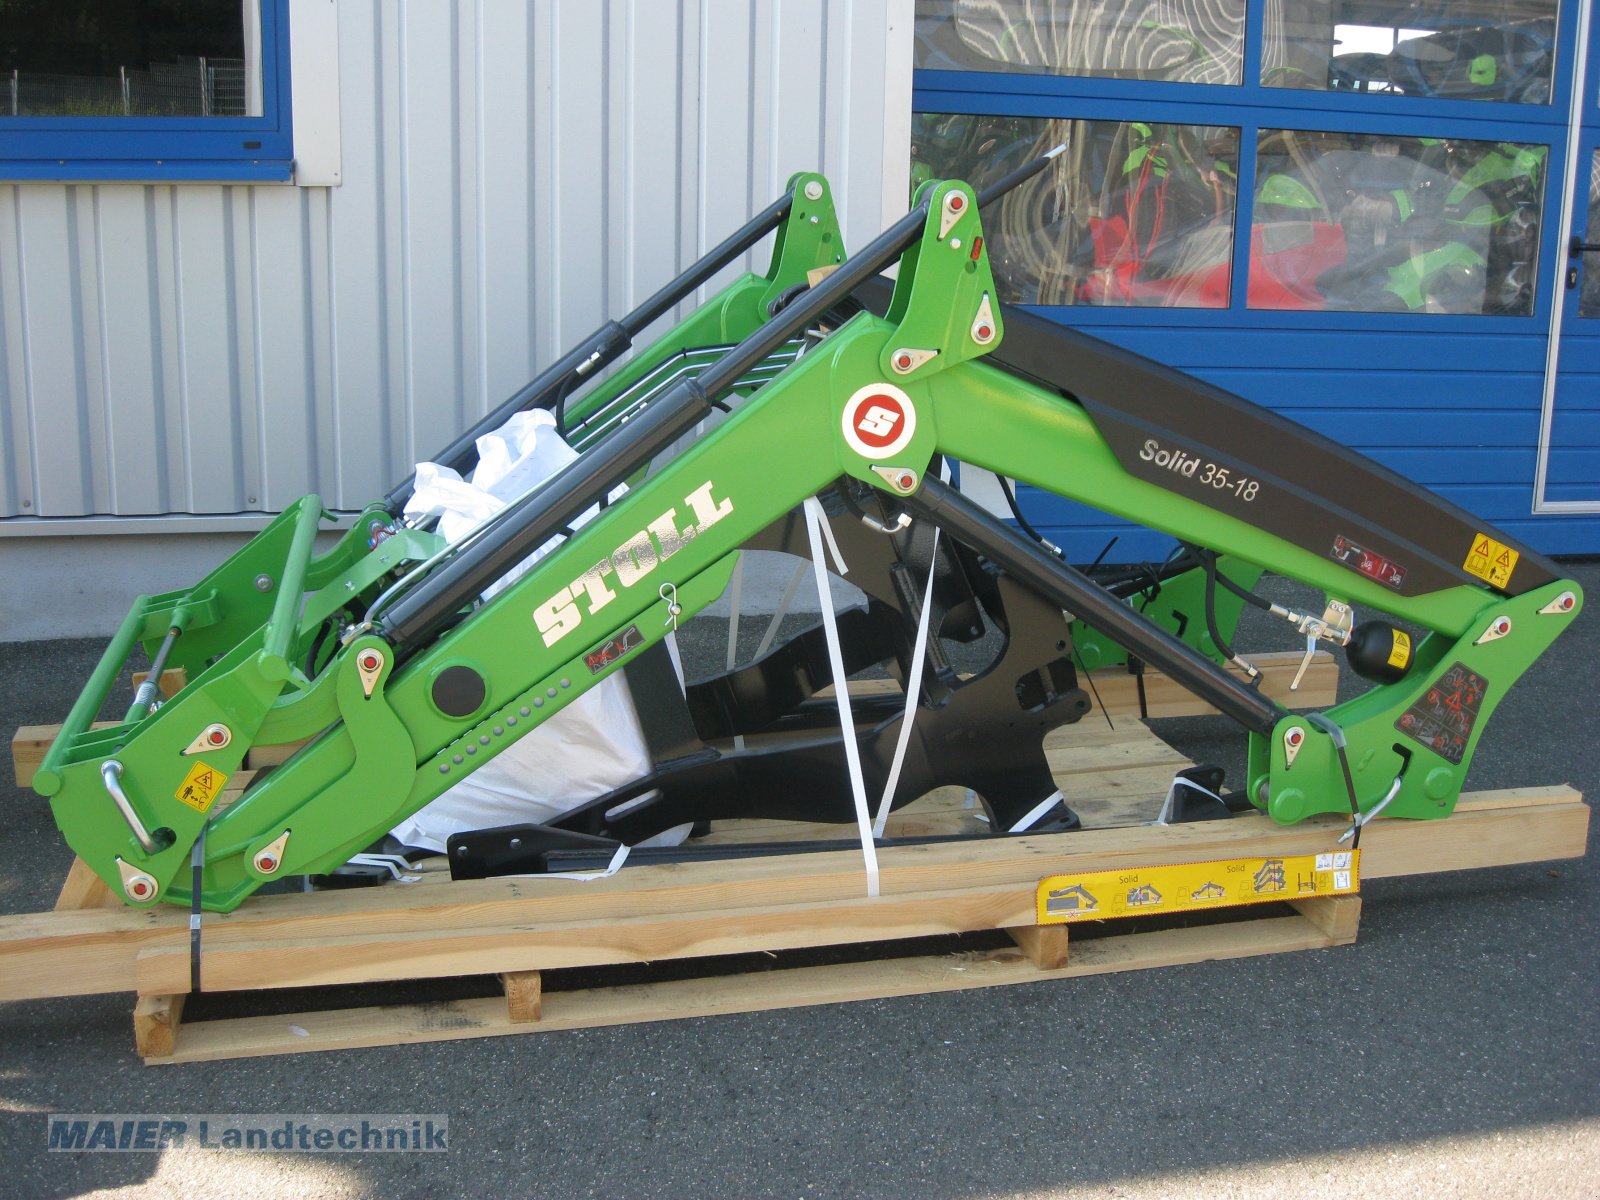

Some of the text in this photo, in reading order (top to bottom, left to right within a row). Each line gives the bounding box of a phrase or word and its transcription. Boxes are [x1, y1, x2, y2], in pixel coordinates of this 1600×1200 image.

[1140, 439, 1260, 501] Solid 35-18
[533, 480, 734, 648] STOLL
[1119, 875, 1139, 884] Solid
[1226, 864, 1246, 874] Solid
